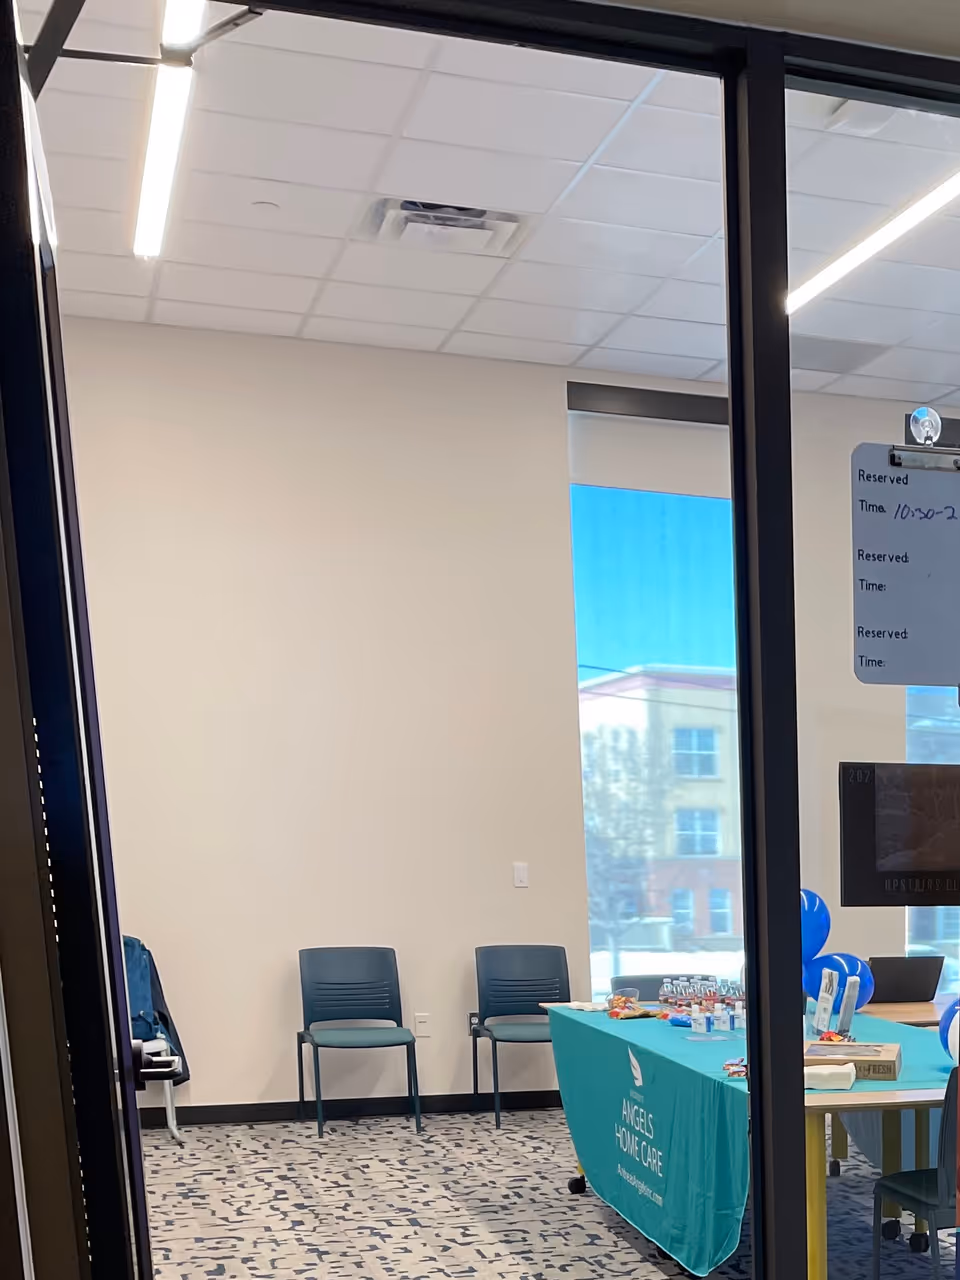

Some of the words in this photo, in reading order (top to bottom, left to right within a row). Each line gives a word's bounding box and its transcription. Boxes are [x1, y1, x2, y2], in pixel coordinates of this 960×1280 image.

[858, 578, 886, 592] Time:
[622, 1097, 654, 1139] ANGELS
[614, 1122, 640, 1162] HOME
[641, 1140, 663, 1178] CARE
